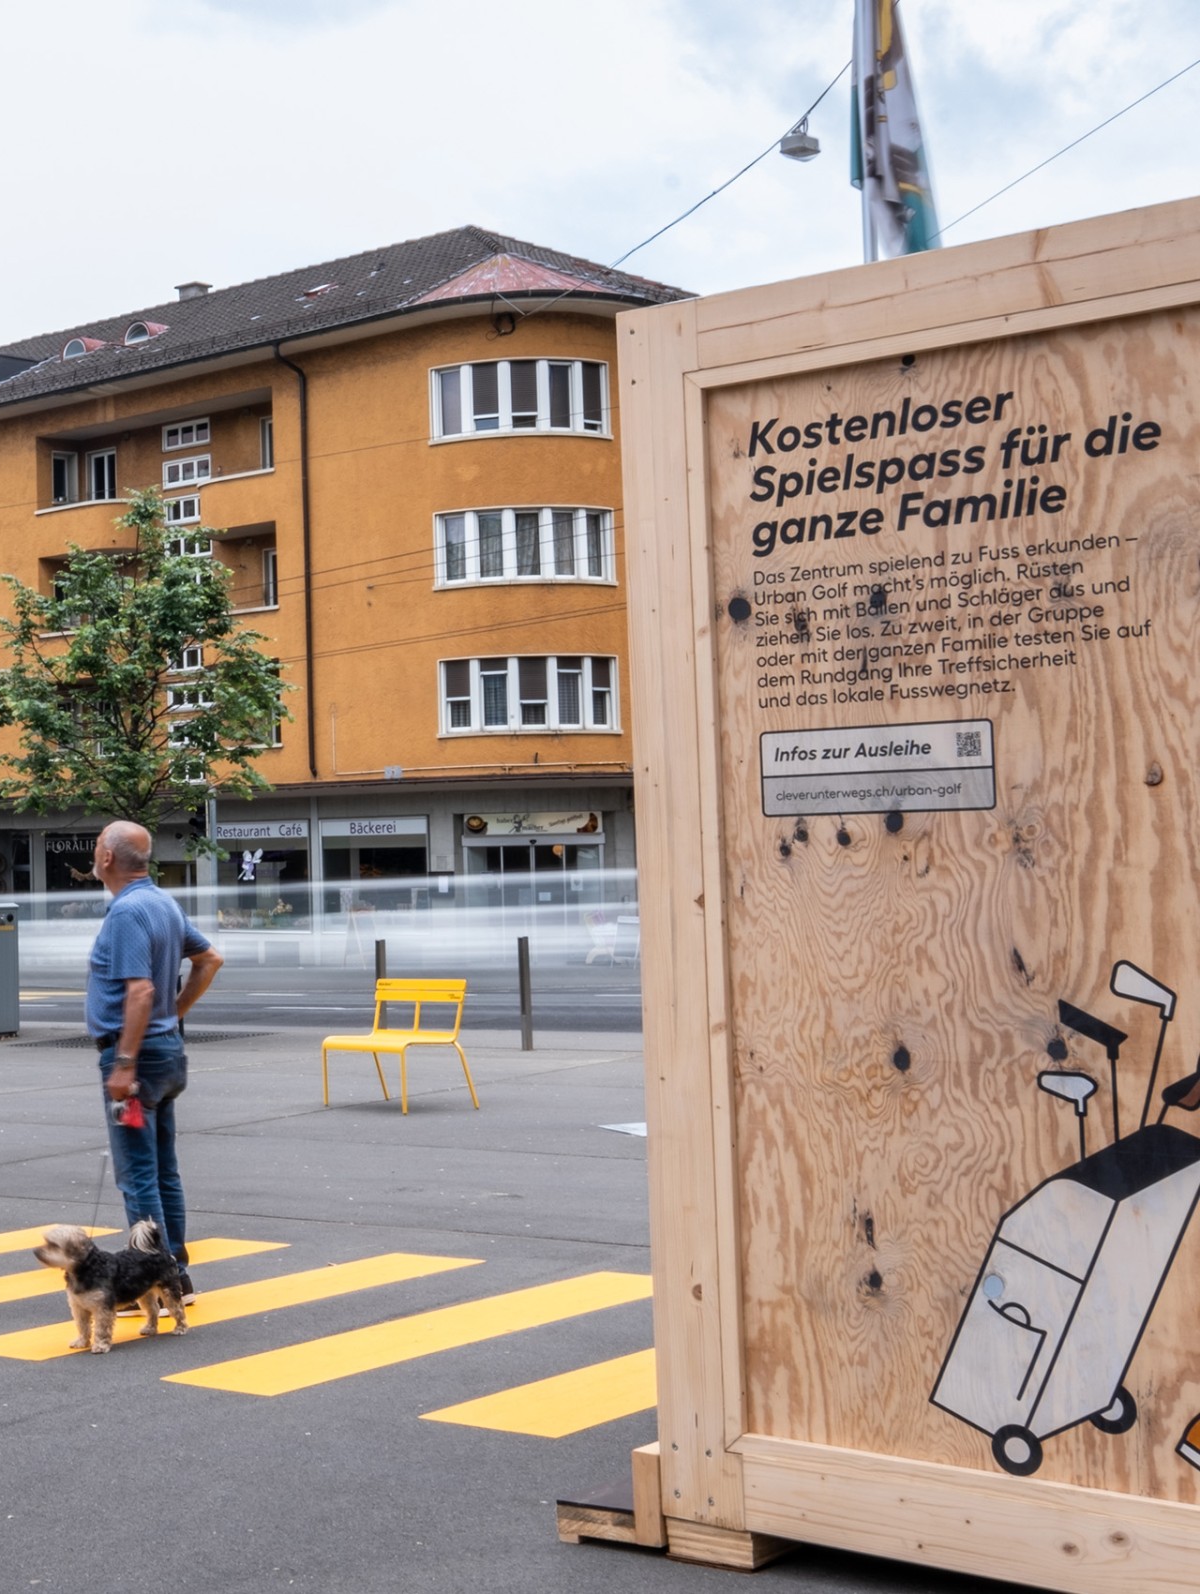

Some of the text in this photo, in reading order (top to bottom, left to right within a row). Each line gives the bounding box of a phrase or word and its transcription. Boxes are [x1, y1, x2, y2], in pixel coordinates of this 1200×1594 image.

[747, 391, 1014, 458] Kostenloser
[749, 411, 1162, 507] Spielspass für die
[752, 475, 1067, 558] ganze Familie
[753, 534, 1120, 585] Das Zentrum spielend zu Fuss erkunden
[754, 590, 806, 606] Urban
[812, 582, 848, 600] Golf
[930, 567, 1011, 590] möglich.
[1017, 561, 1083, 580] Rüsten
[755, 611, 779, 626] Sie
[785, 608, 817, 624] sich
[823, 604, 850, 620] mit
[916, 594, 951, 611] und
[958, 588, 1042, 608] Schläger
[1050, 584, 1085, 599] aus
[1092, 576, 1130, 595] und
[756, 605, 1104, 647] ziehen Sie los. Zu zweit, in der Gruppe
[757, 619, 1151, 667] oder mit der ganzen Familie testen Sie auf
[758, 650, 1077, 688] dem Rundgang Ihre Treffsicherheit
[759, 679, 1016, 708] und das lokale Fusswegnetz.
[774, 740, 931, 762] Infos zur Ausleihe
[776, 783, 962, 801] cleverunterwegs.ch/urban-golf
[46, 840, 96, 854] FLORALIF
[217, 824, 302, 837] Restaurant Café
[350, 821, 397, 834] Bäckerei
